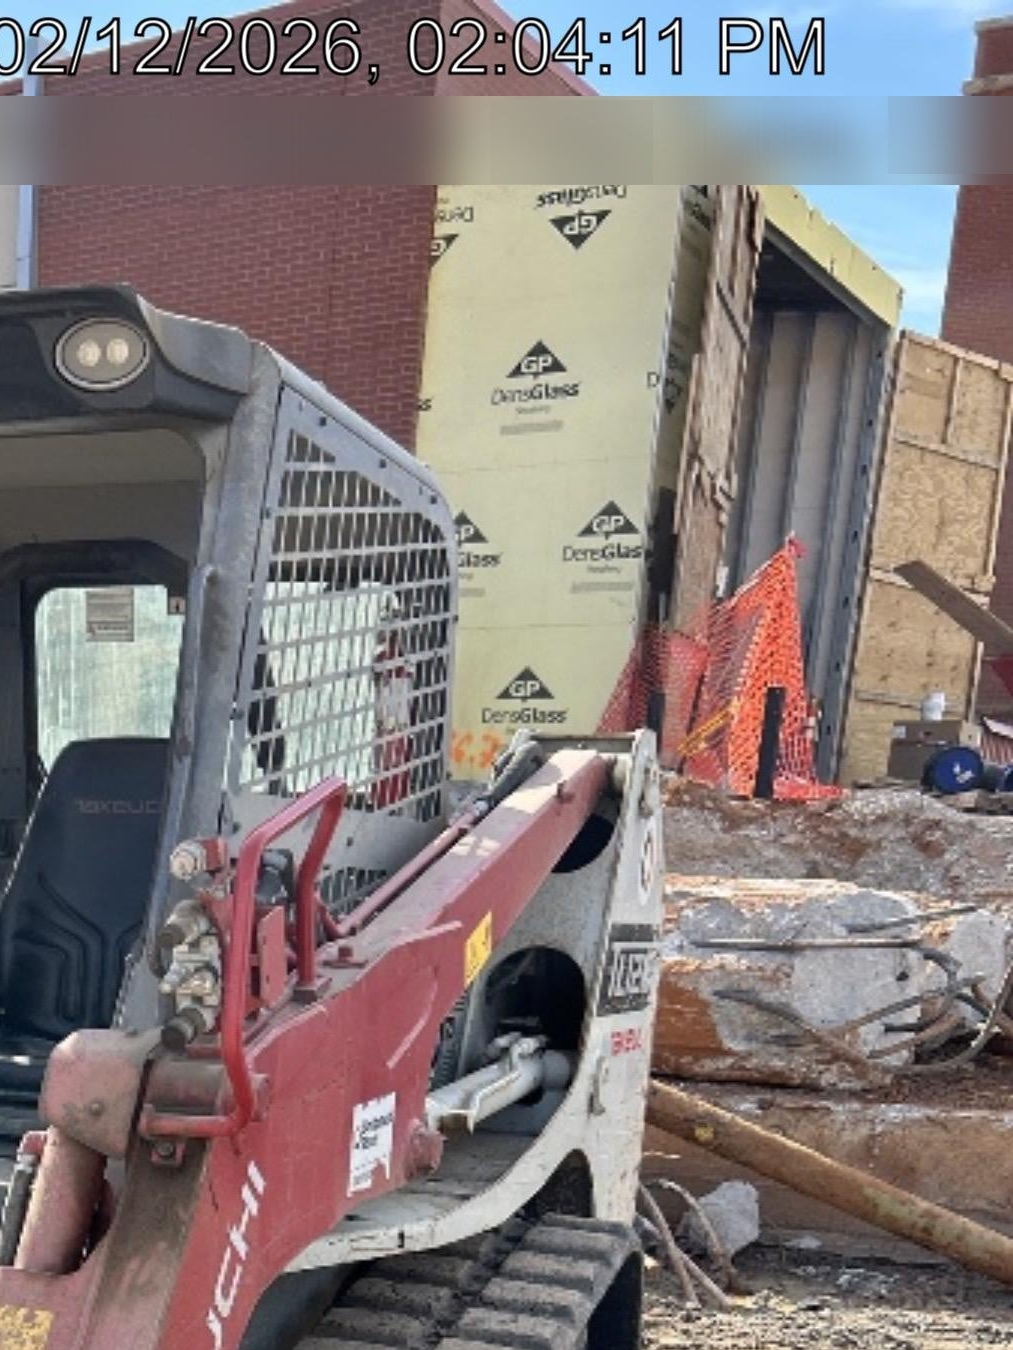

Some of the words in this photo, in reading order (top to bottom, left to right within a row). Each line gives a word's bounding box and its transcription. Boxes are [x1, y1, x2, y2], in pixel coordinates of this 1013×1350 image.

[563, 215, 598, 235] GP
[520, 356, 553, 374] GP
[491, 382, 582, 405] DensGlass
[592, 515, 625, 532] GP
[509, 681, 540, 697] GP
[481, 707, 568, 724] DensGlass
